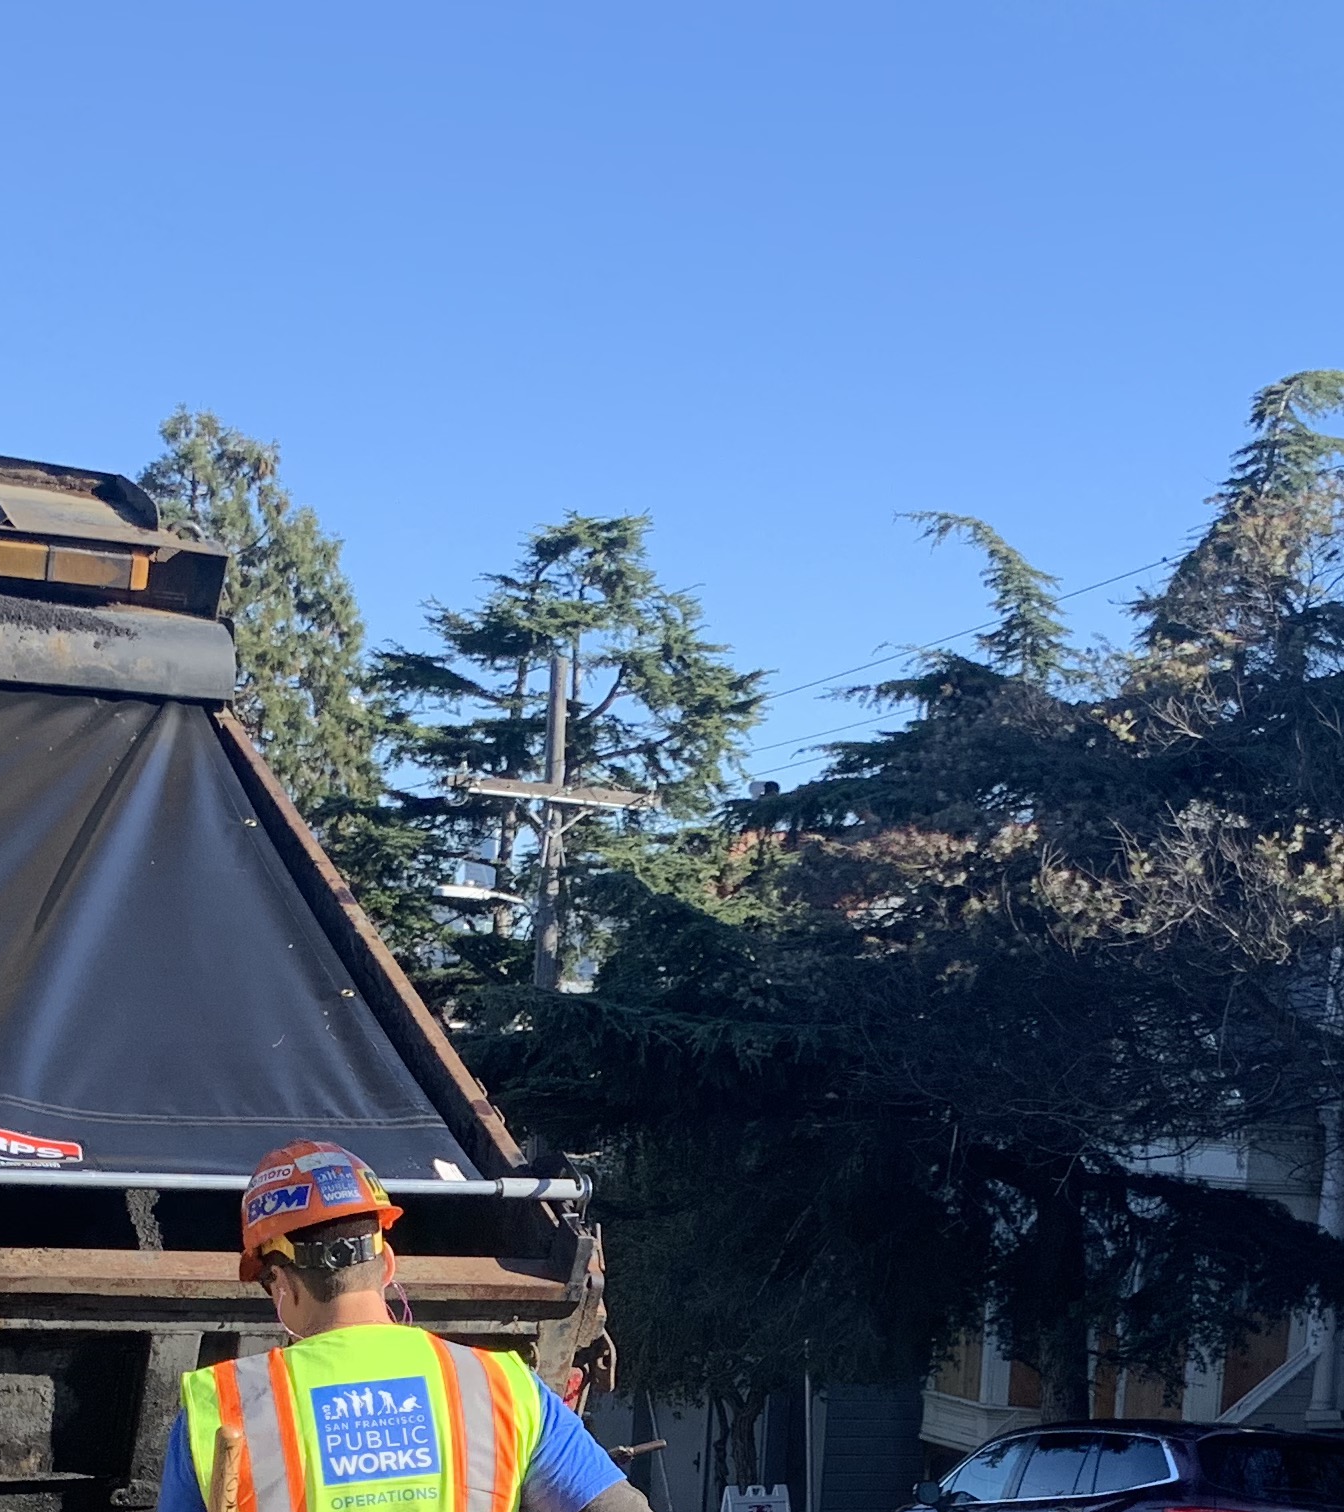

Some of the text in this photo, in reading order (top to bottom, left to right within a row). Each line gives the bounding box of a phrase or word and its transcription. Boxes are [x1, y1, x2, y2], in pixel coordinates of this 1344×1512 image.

[325, 1415, 425, 1433] SAN FRANCISCO
[326, 1425, 429, 1453] PUBLIC
[329, 1447, 433, 1477] WORKS
[331, 1487, 438, 1510] OPERATIONS
